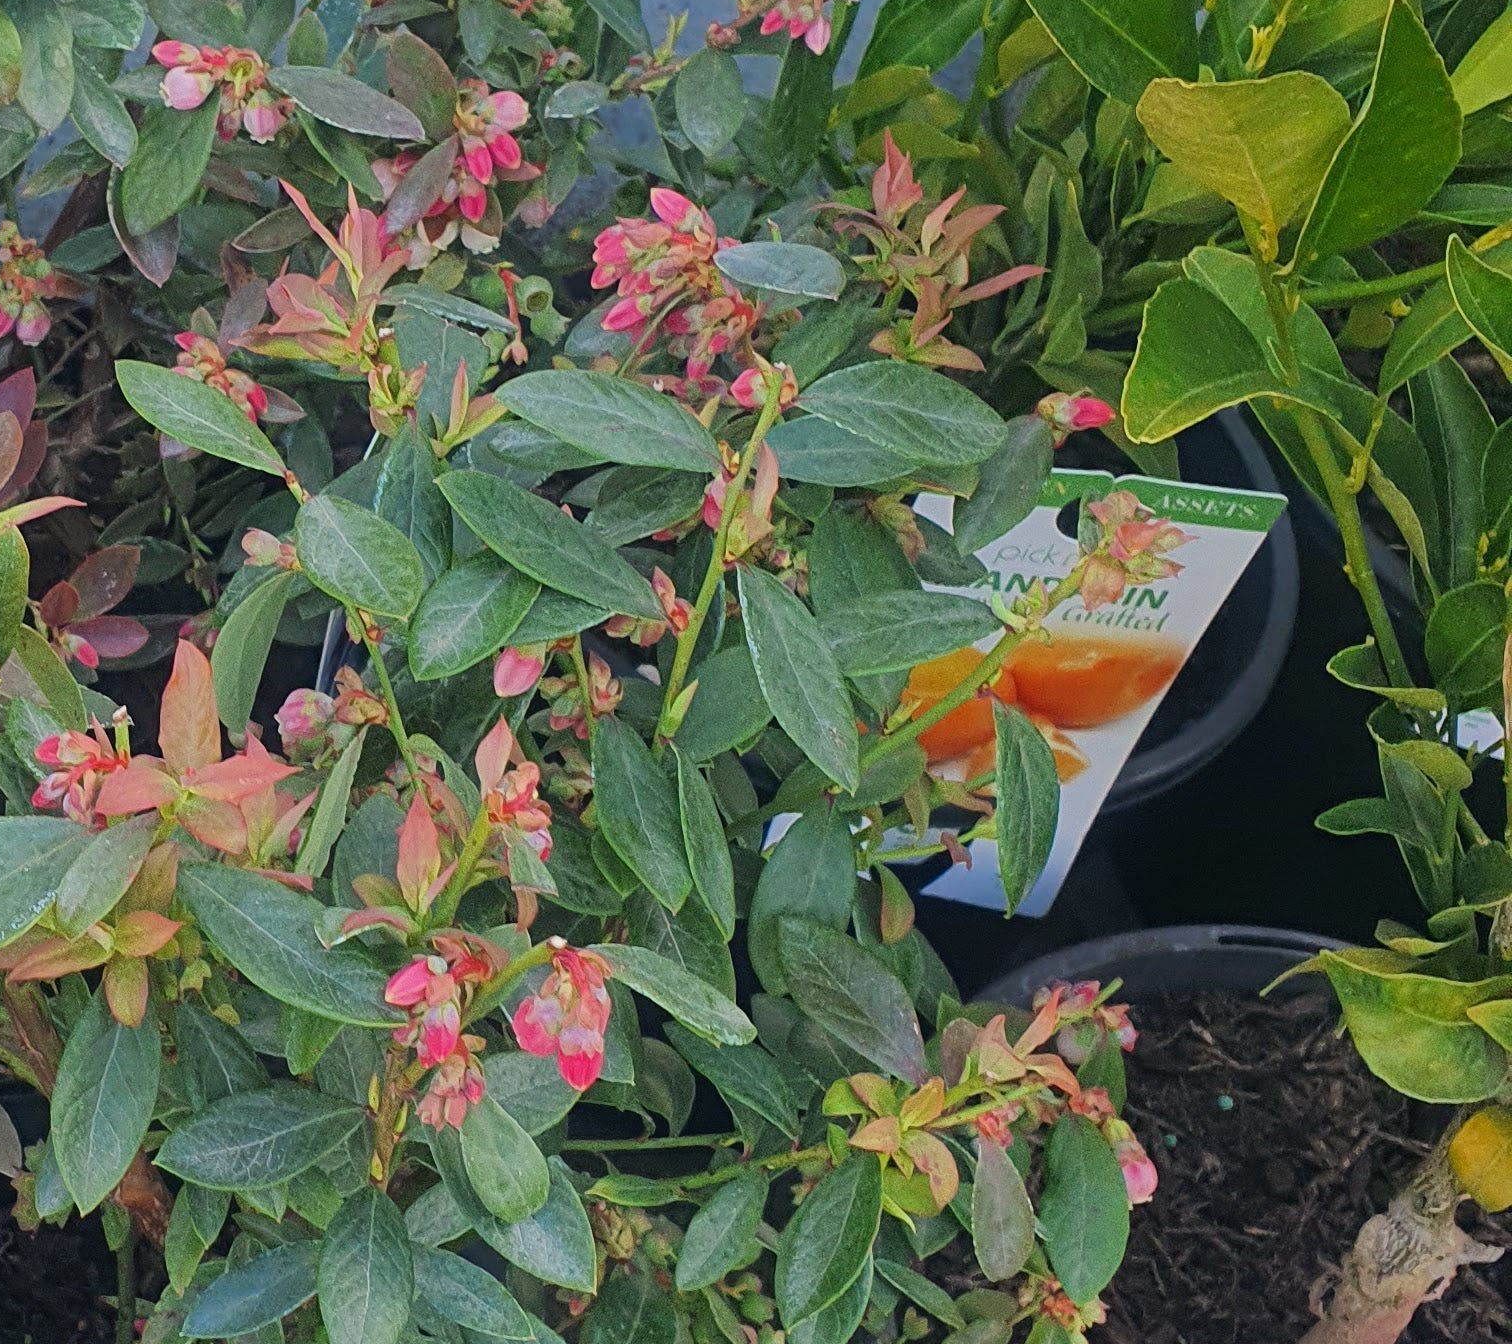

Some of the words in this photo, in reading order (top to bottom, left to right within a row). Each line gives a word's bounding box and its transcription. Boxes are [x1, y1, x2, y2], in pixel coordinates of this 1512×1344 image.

[1155, 494, 1258, 518] ASSETS
[992, 542, 1060, 568] pick
[975, 570, 1170, 609] ANIN
[1061, 607, 1171, 632] Grafted
